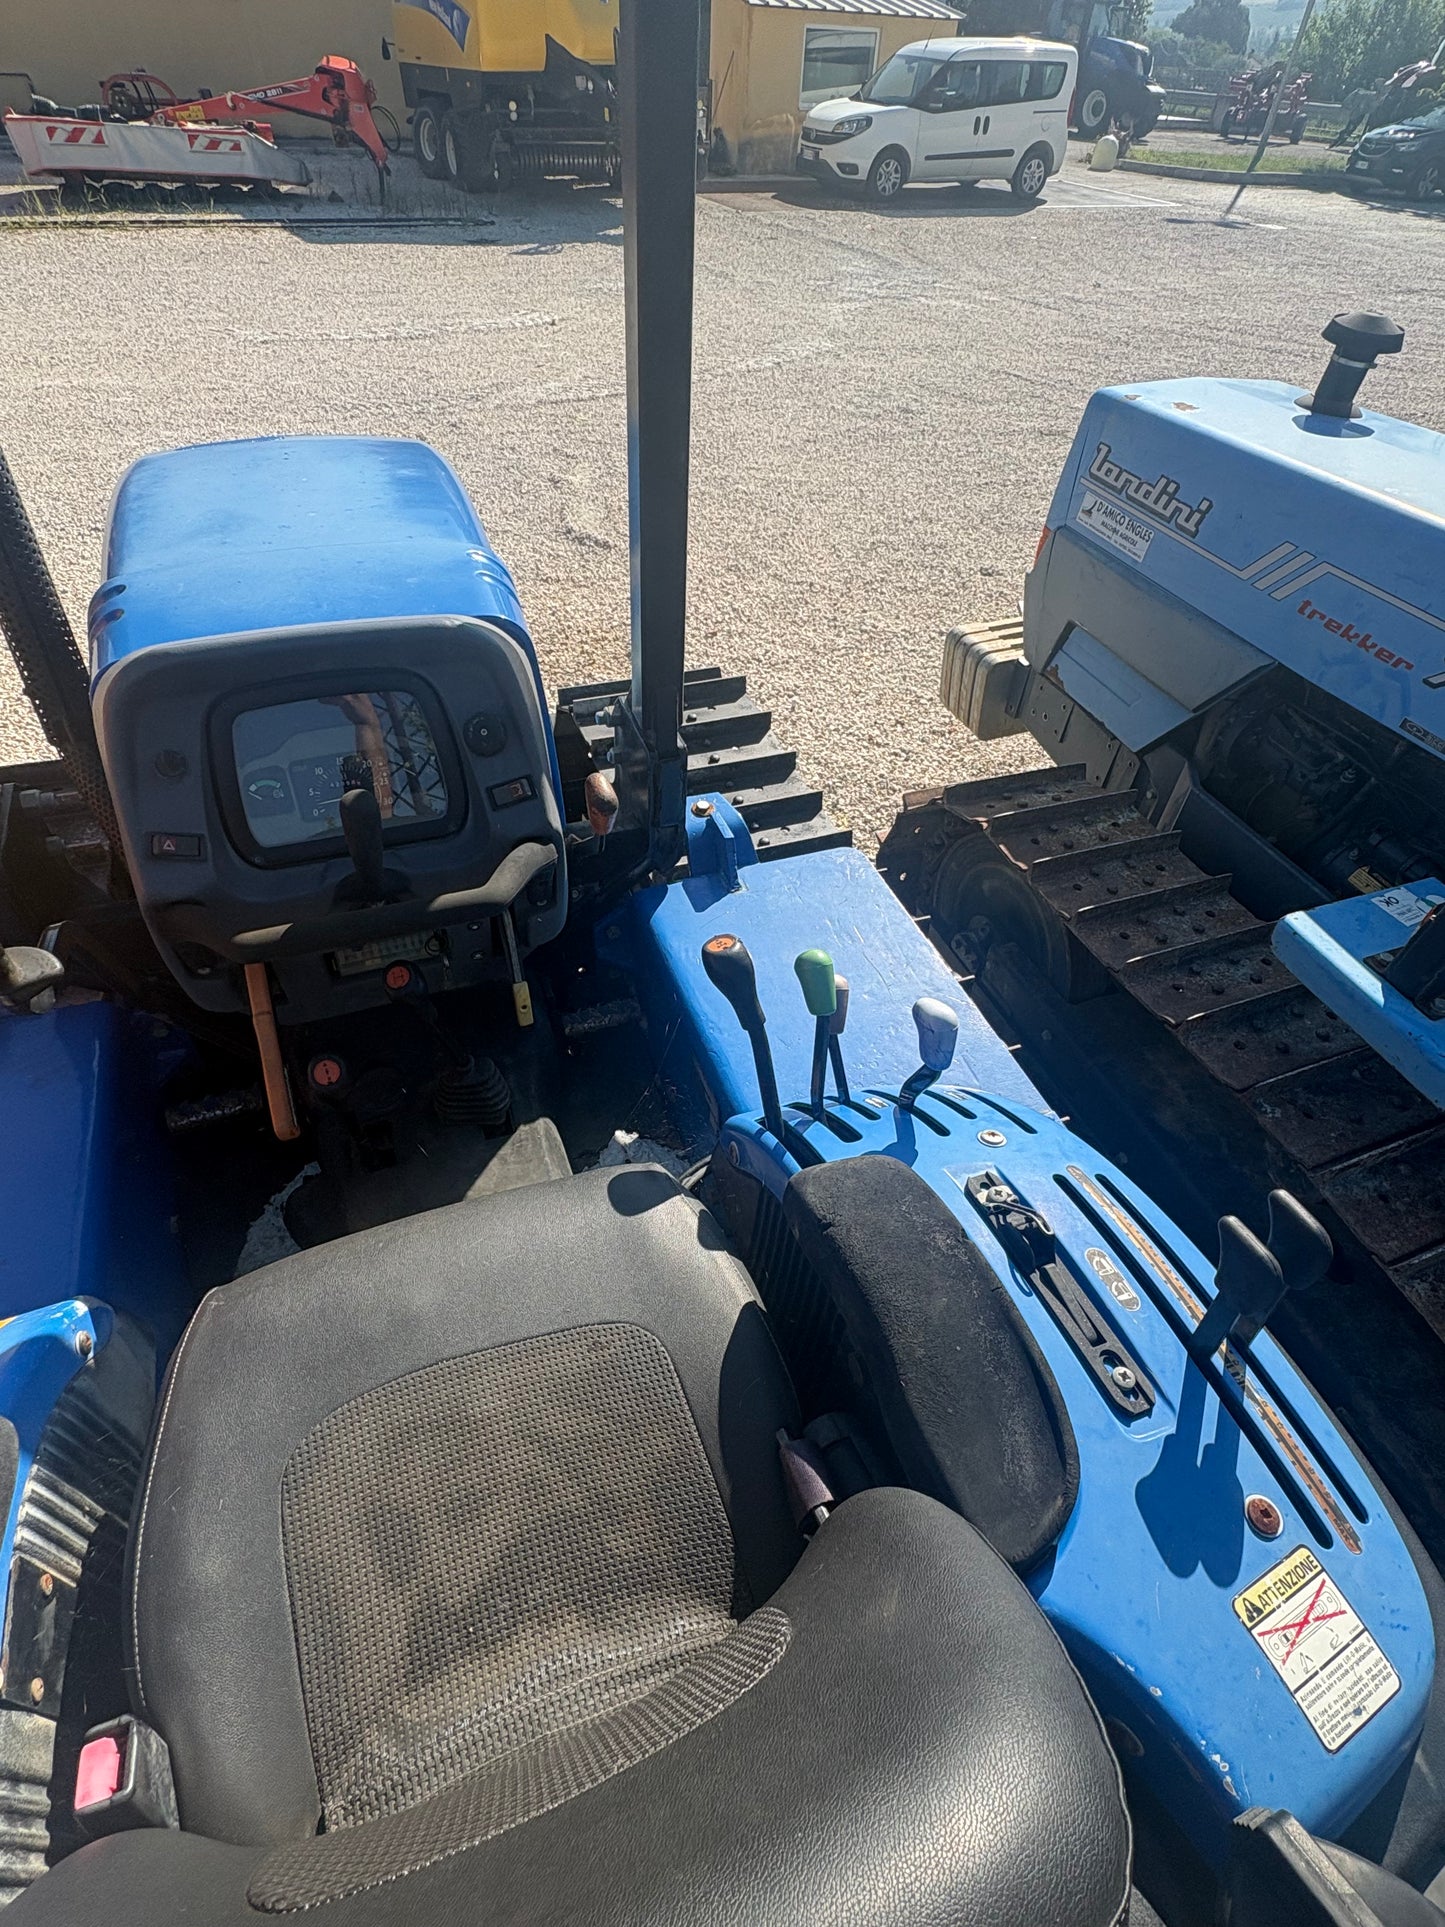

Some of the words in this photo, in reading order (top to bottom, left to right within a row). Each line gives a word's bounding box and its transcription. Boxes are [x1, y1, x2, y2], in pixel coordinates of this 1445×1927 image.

[1088, 441, 1213, 538] Landini
[1125, 519, 1152, 543] ENGLES
[1297, 599, 1416, 672] trekker
[1258, 1554, 1319, 1610] ATTENZIONE
